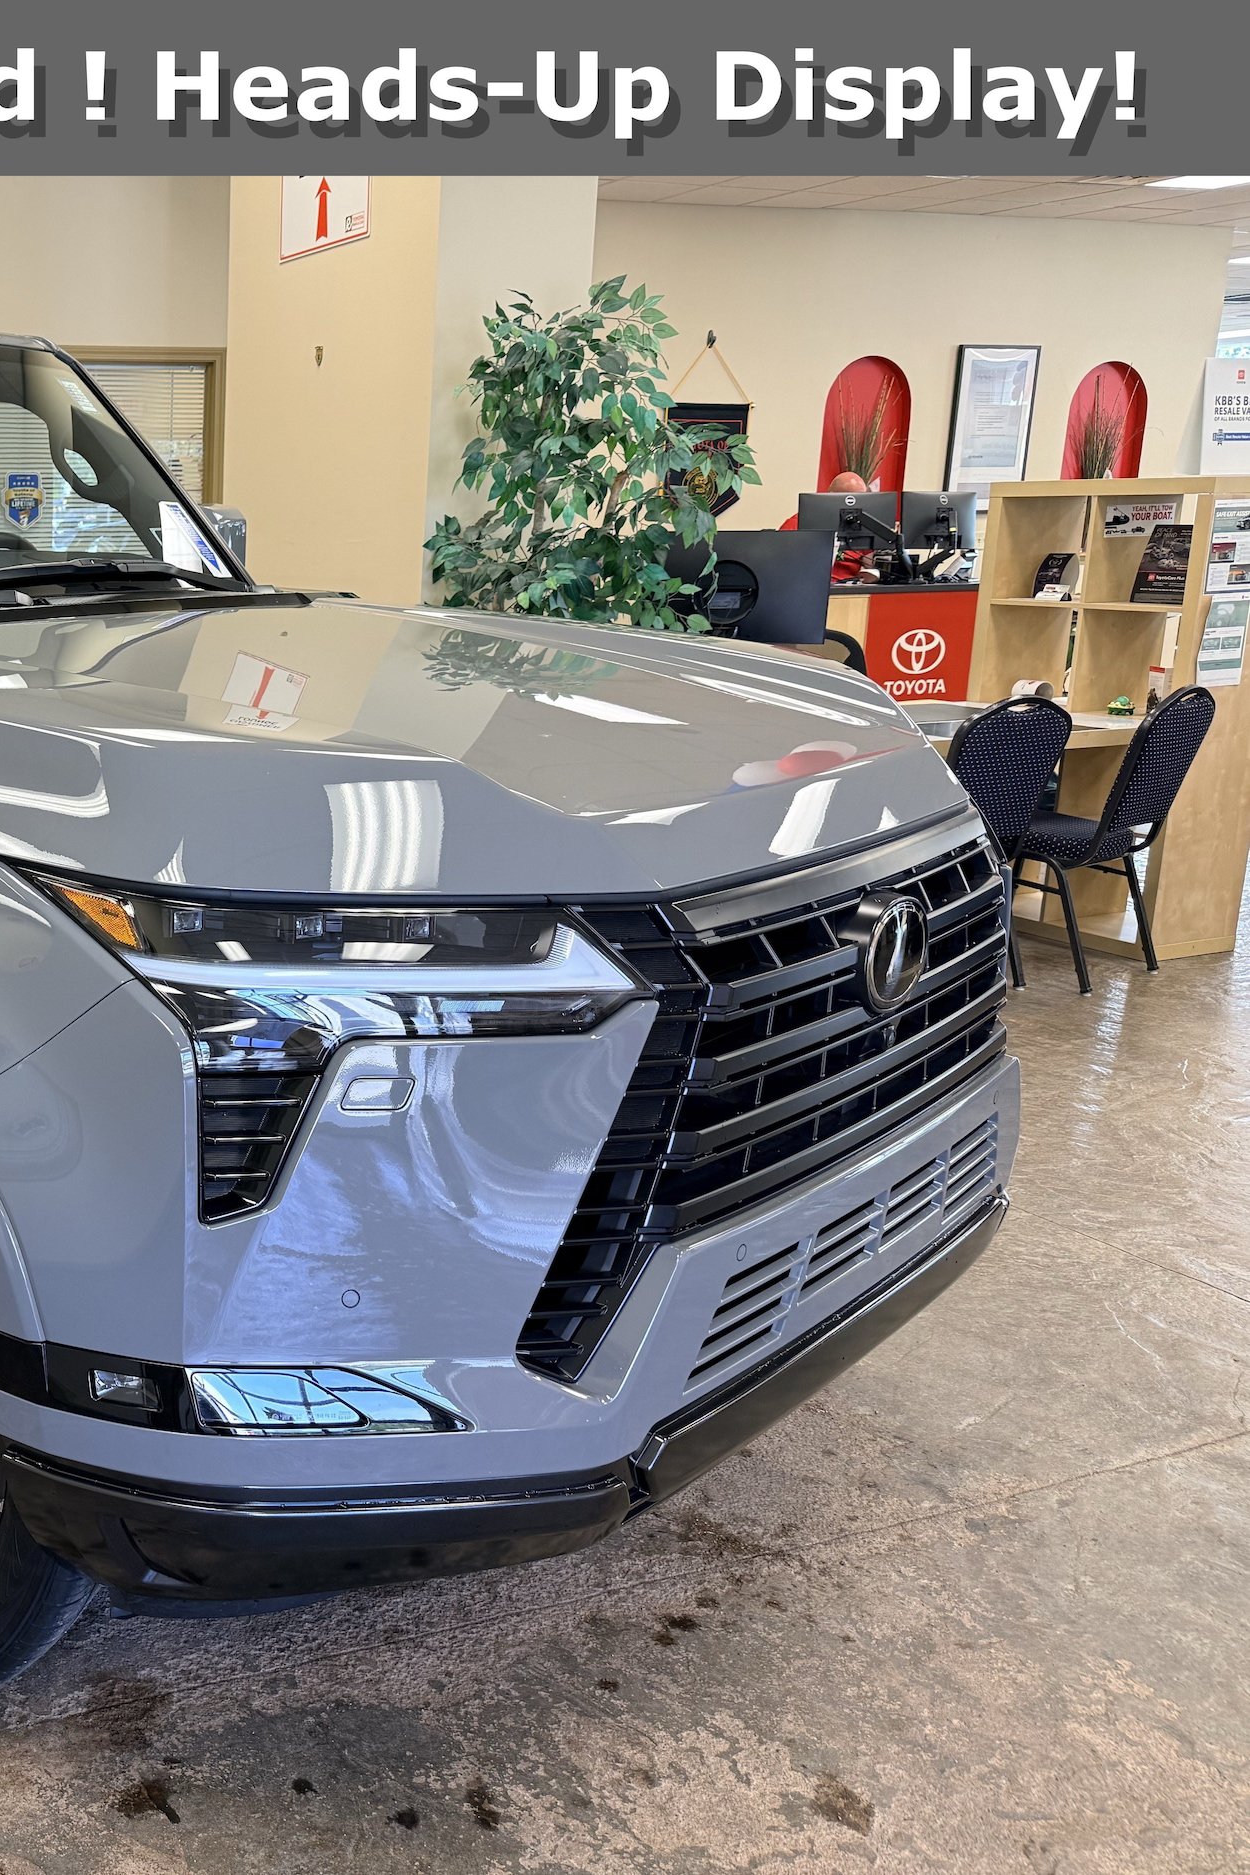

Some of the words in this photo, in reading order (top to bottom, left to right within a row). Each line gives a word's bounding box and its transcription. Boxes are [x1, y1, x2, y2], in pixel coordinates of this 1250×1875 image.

[1214, 395, 1241, 406] KBB'S
[1243, 396, 1250, 406] B
[1214, 407, 1241, 415] RESALE
[1131, 512, 1151, 521] YOUR
[883, 679, 946, 696] TOYOTA
